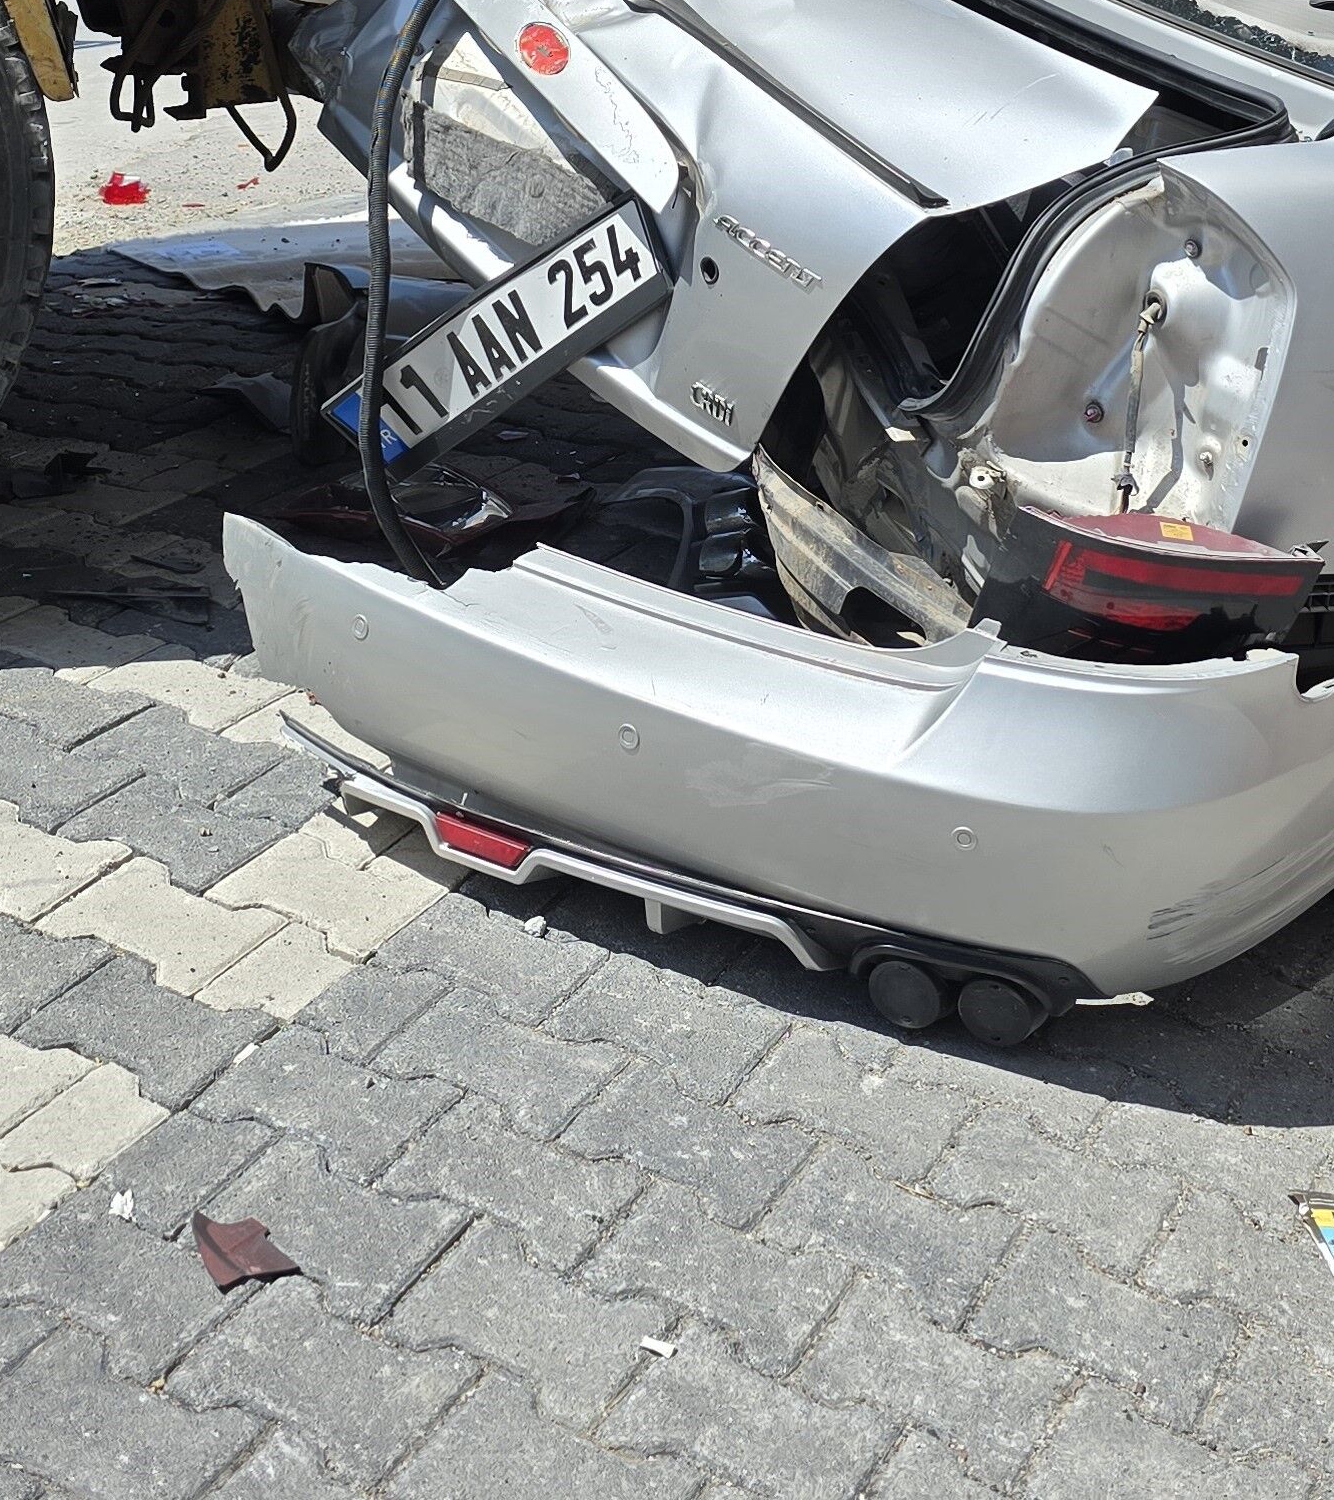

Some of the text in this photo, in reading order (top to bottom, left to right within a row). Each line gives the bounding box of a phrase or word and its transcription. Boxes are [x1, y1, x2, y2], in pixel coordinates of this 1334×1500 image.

[446, 289, 544, 399] AAN
[547, 224, 642, 330] 254
[380, 429, 398, 449] R
